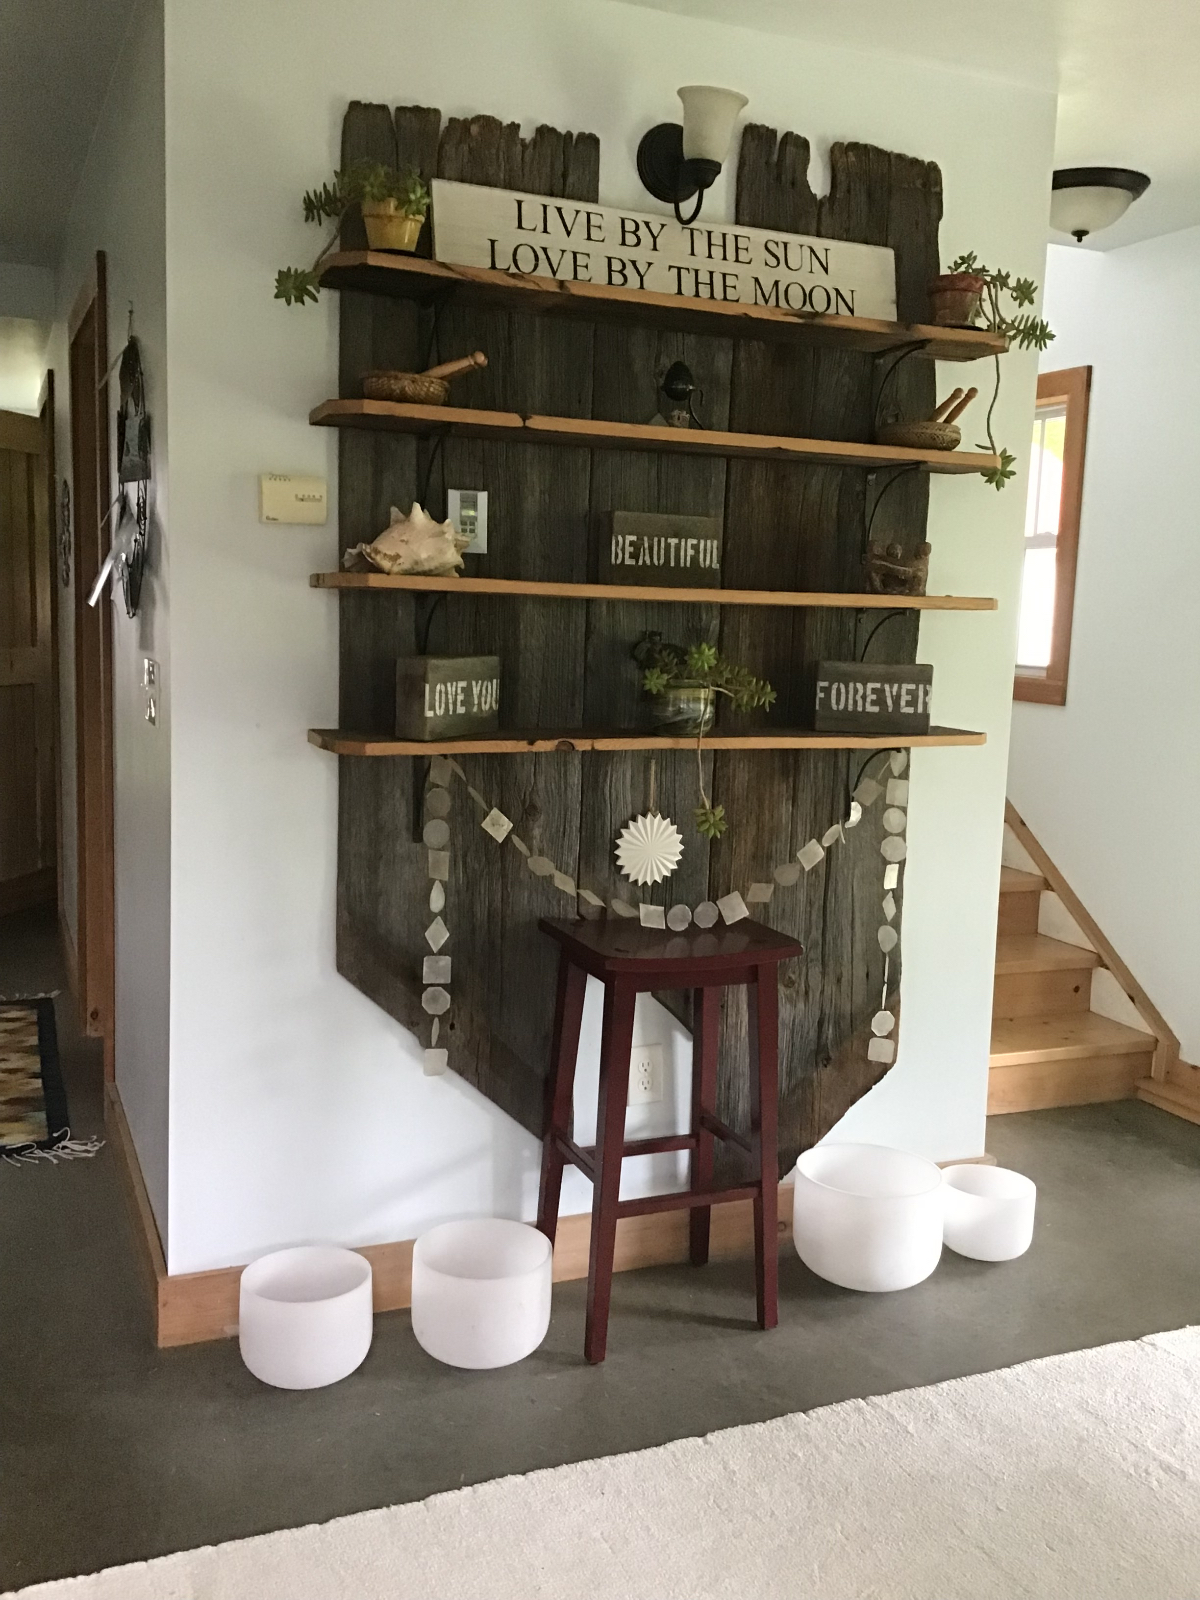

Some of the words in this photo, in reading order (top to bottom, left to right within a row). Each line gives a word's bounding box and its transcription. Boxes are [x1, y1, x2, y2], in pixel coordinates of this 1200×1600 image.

[514, 198, 606, 243] LIVE
[619, 216, 667, 251] BY
[681, 226, 753, 265] THE
[763, 238, 831, 276] SUN
[487, 238, 592, 283] LOVE
[605, 256, 654, 290] BY
[668, 264, 741, 302] THE
[751, 276, 856, 317] MOON
[611, 534, 720, 569] BEAUTIFUL
[424, 680, 467, 717] LOVE
[472, 678, 500, 713] YOU
[815, 681, 932, 714] FOREVER
